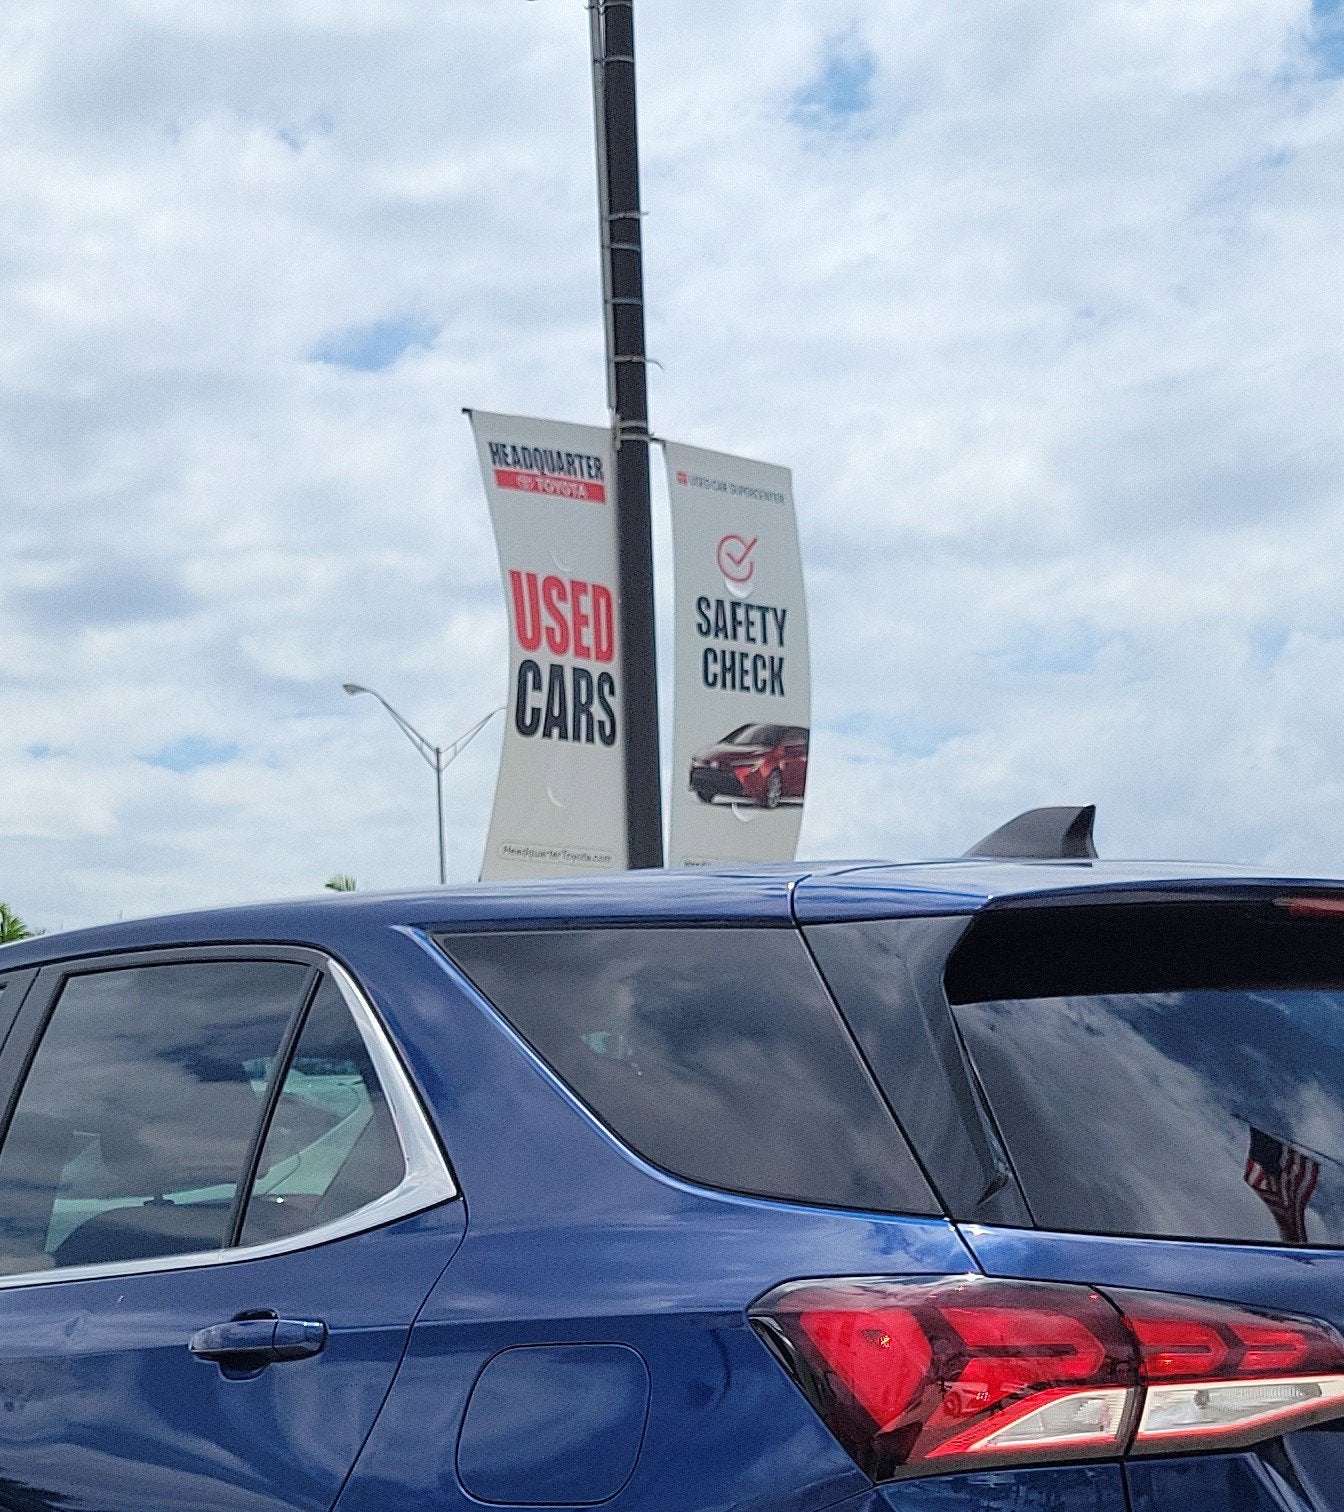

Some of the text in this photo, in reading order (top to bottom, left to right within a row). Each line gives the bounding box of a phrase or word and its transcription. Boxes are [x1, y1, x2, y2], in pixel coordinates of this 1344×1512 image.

[488, 441, 604, 482] HEADQUARTER
[536, 477, 587, 499] TOYOTA
[509, 569, 616, 663] USED
[696, 596, 788, 647] SAFETY
[703, 647, 785, 697] CHECK
[515, 659, 617, 746] CARS
